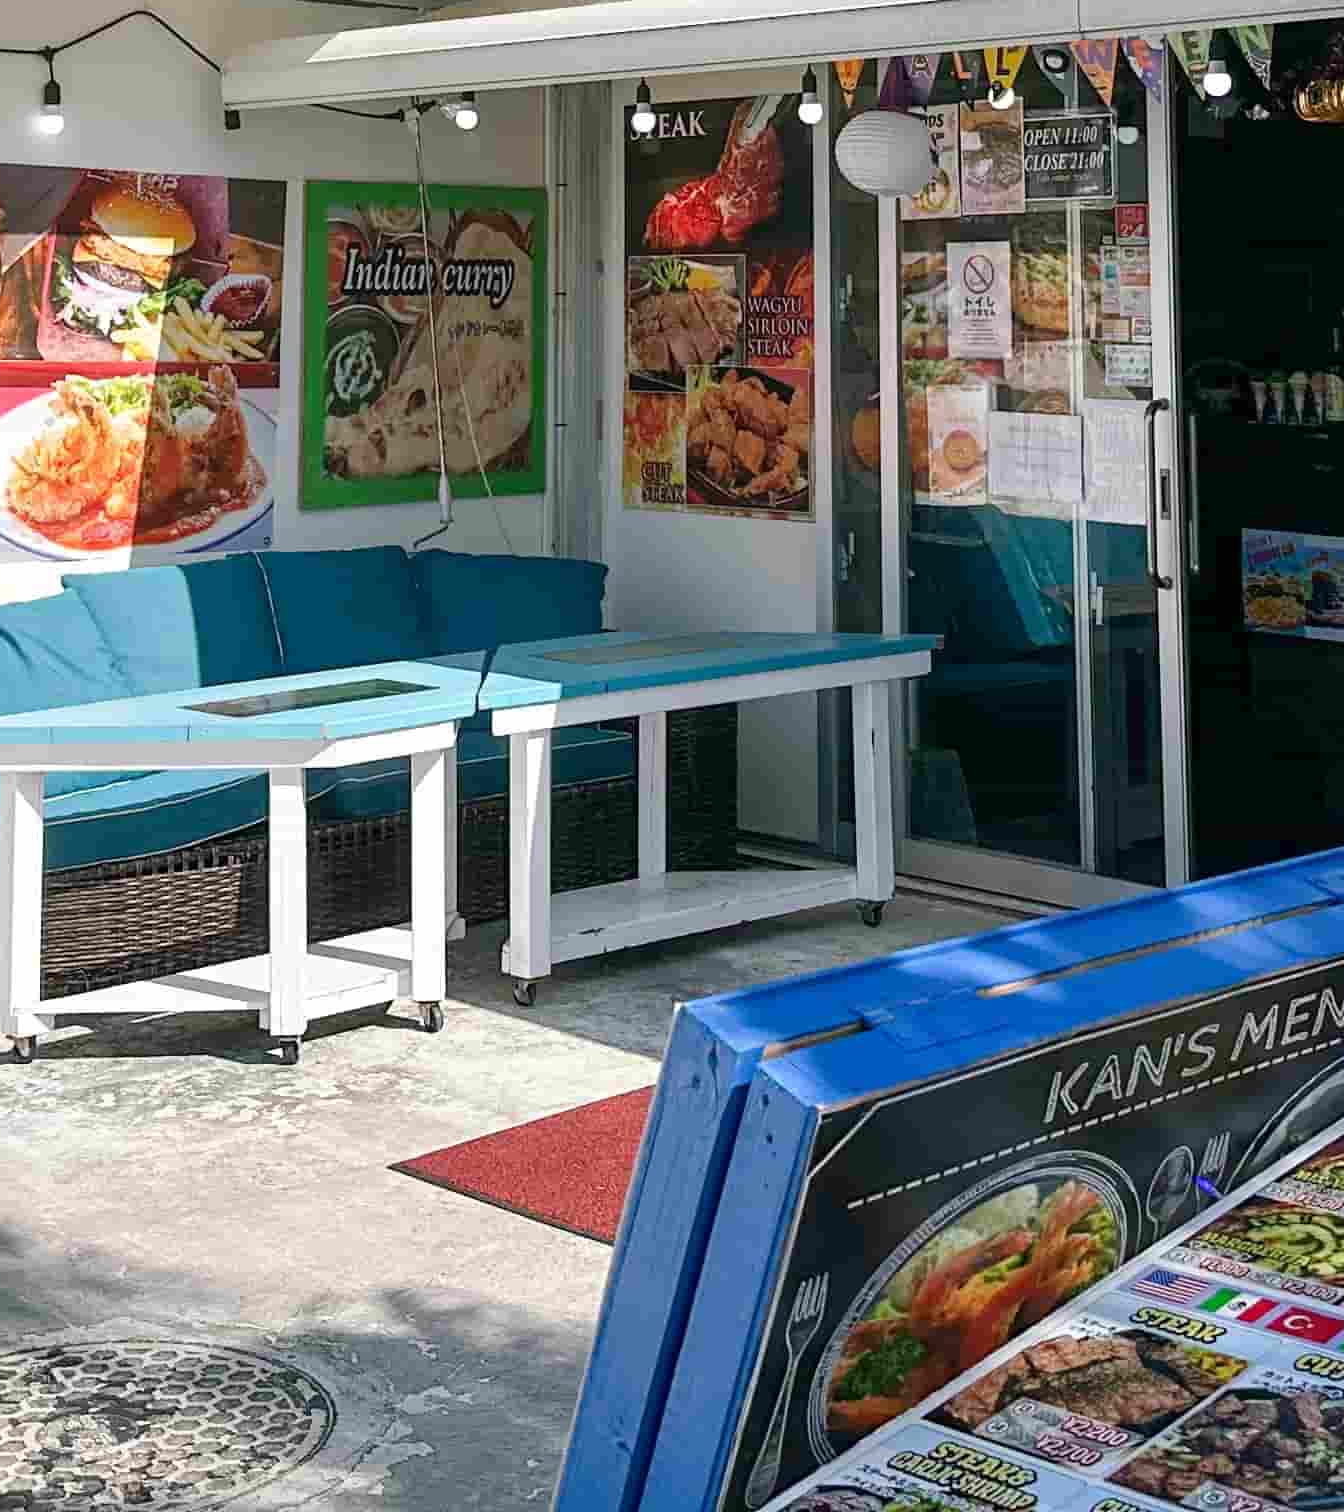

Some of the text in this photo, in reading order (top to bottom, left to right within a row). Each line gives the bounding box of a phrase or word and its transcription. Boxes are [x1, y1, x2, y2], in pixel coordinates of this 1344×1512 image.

[1023, 125, 1098, 147] OPEN 11:00
[1023, 150, 1105, 171] CLOSE 21:00
[344, 247, 516, 310] Indian curry
[746, 295, 803, 315] WAGYU
[746, 316, 809, 337] SIRLOIN
[746, 337, 794, 358] STEAK
[1042, 1022, 1224, 1125] KAN'S
[1129, 1306, 1227, 1345] STEAK
[886, 1450, 960, 1488] GARLIC
[955, 1471, 1038, 1511] SHRIMP
